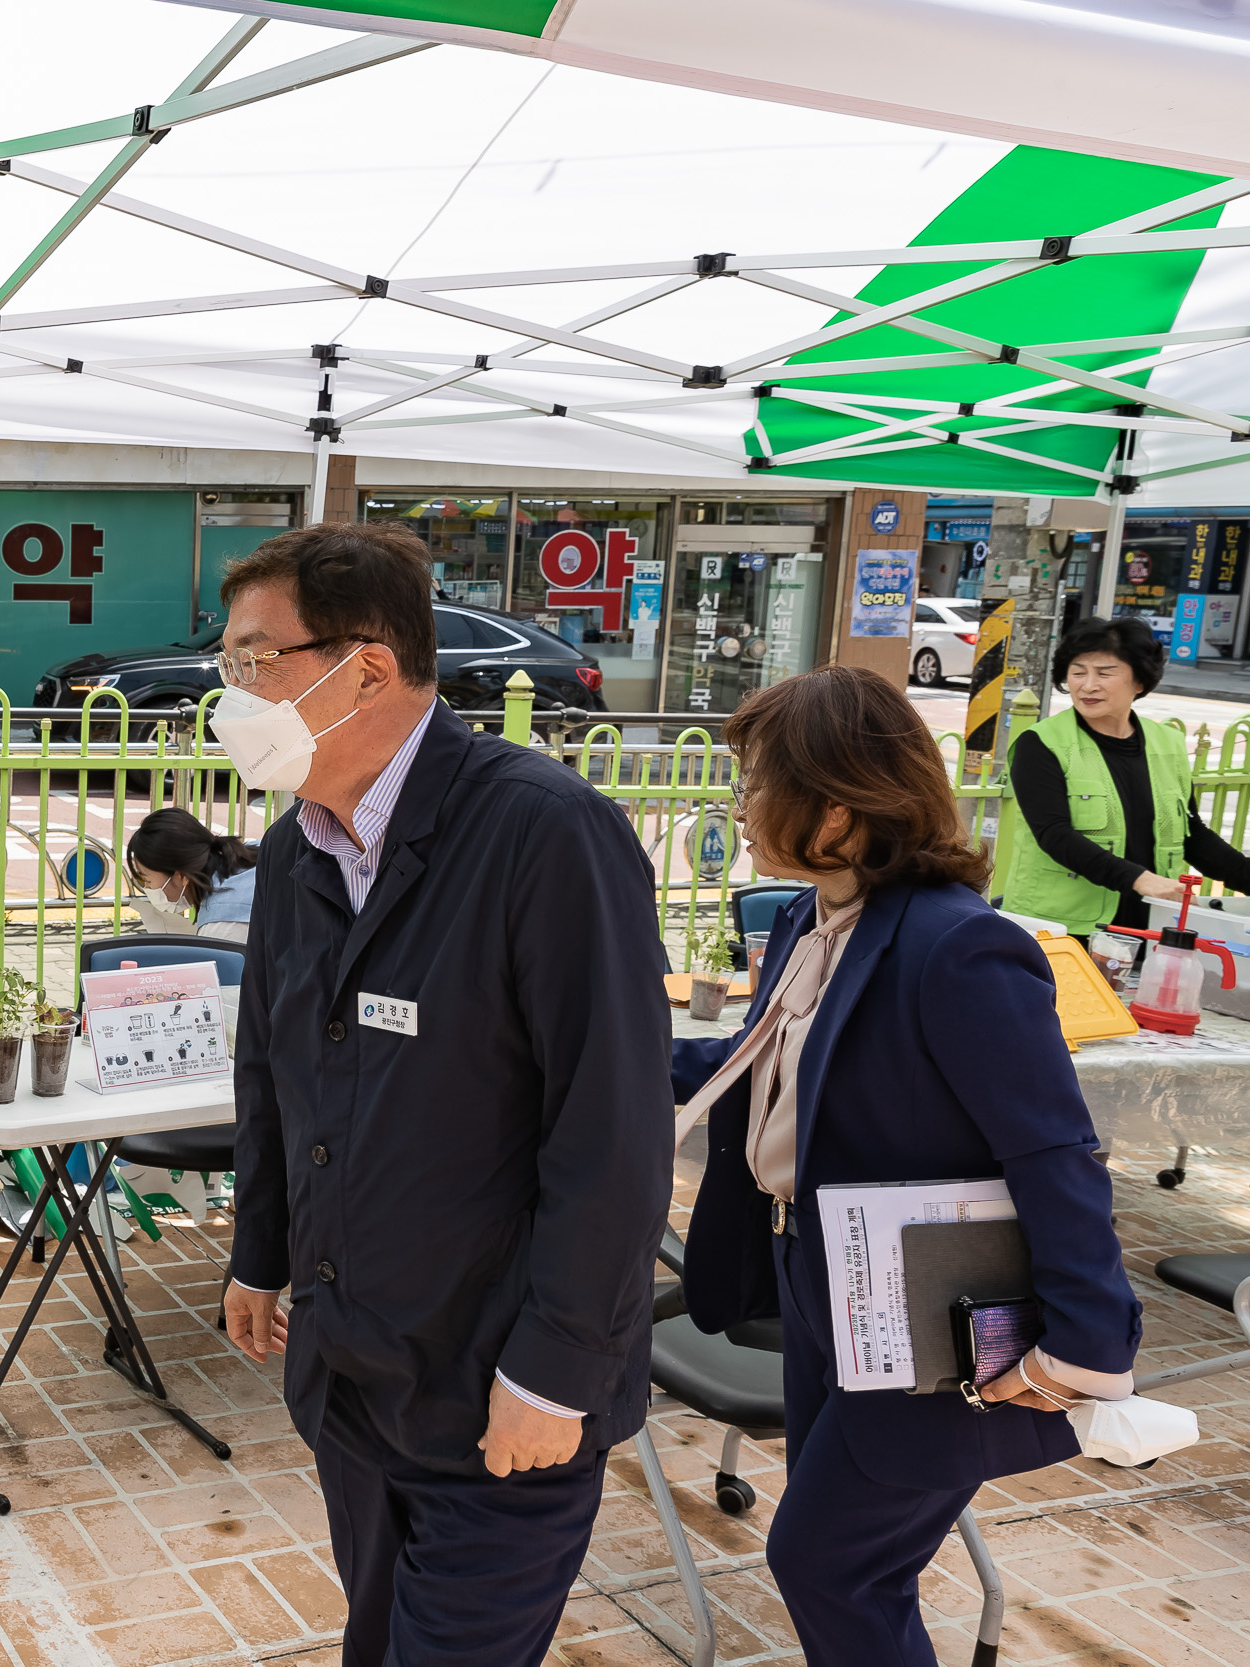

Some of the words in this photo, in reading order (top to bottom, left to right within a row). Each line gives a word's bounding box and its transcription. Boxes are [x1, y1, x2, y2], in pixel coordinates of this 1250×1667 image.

[874, 511, 897, 524] ADT
[1, 521, 105, 625] 약
[539, 528, 639, 633] 약
[860, 591, 907, 606] 원아모집
[139, 975, 163, 984] 2023
[846, 1207, 856, 1223] 계획
[849, 1226, 860, 1241] 표창
[853, 1244, 862, 1267] 유공자
[855, 1271, 865, 1301] 경로축제
[858, 1304, 866, 1312] 및
[858, 1315, 869, 1338] 기념식
[858, 1341, 874, 1373] 어버이날
